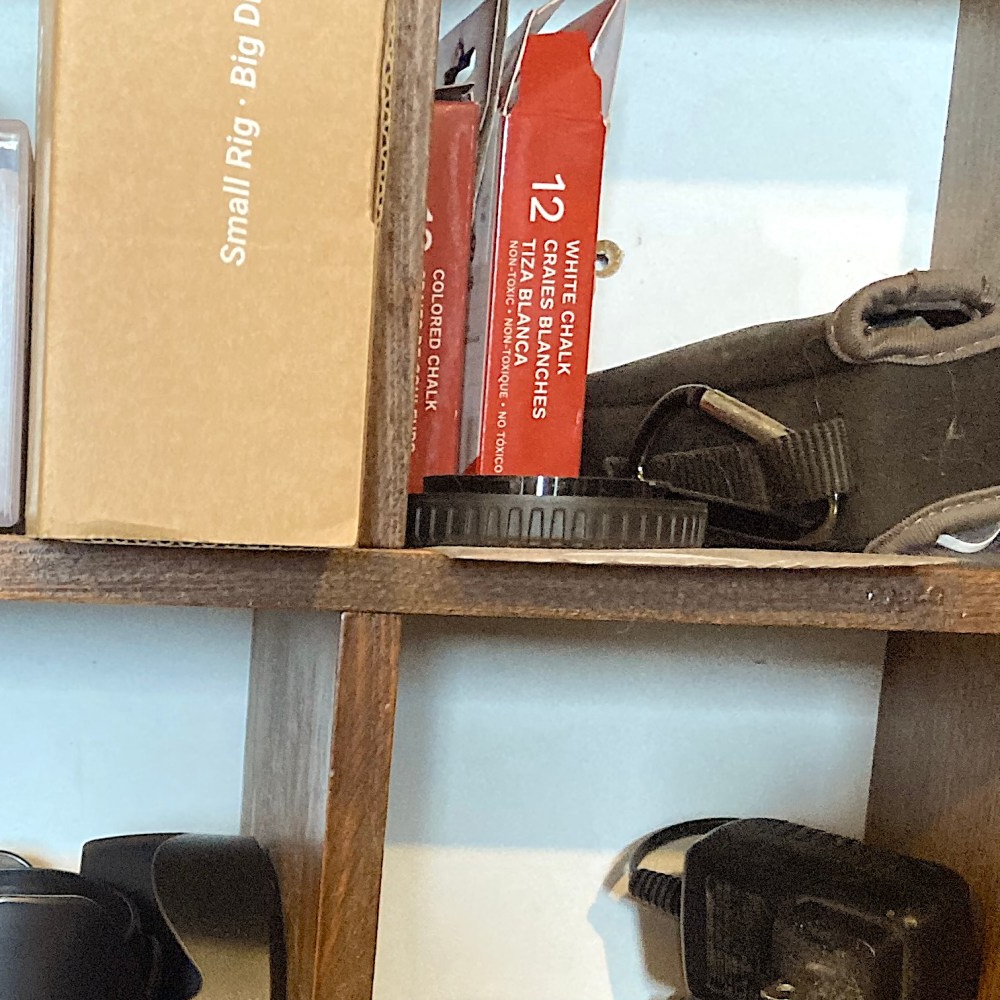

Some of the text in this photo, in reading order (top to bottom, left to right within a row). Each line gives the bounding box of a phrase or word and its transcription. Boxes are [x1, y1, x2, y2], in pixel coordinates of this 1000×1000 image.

[230, 35, 265, 89] Big
[225, 116, 261, 169] Rig
[219, 175, 250, 267] Small
[529, 173, 566, 223] 12
[505, 240, 518, 305] NON-TOXIC
[513, 238, 536, 366] TIZA BLANCA
[557, 240, 581, 375] WHITE CHALK
[428, 268, 446, 351] COLORED
[532, 239, 558, 419] CRAIES BLANCHES
[424, 354, 440, 412] CHALK
[498, 318, 513, 398] NON-TOXIQUE
[497, 411, 507, 428] NO
